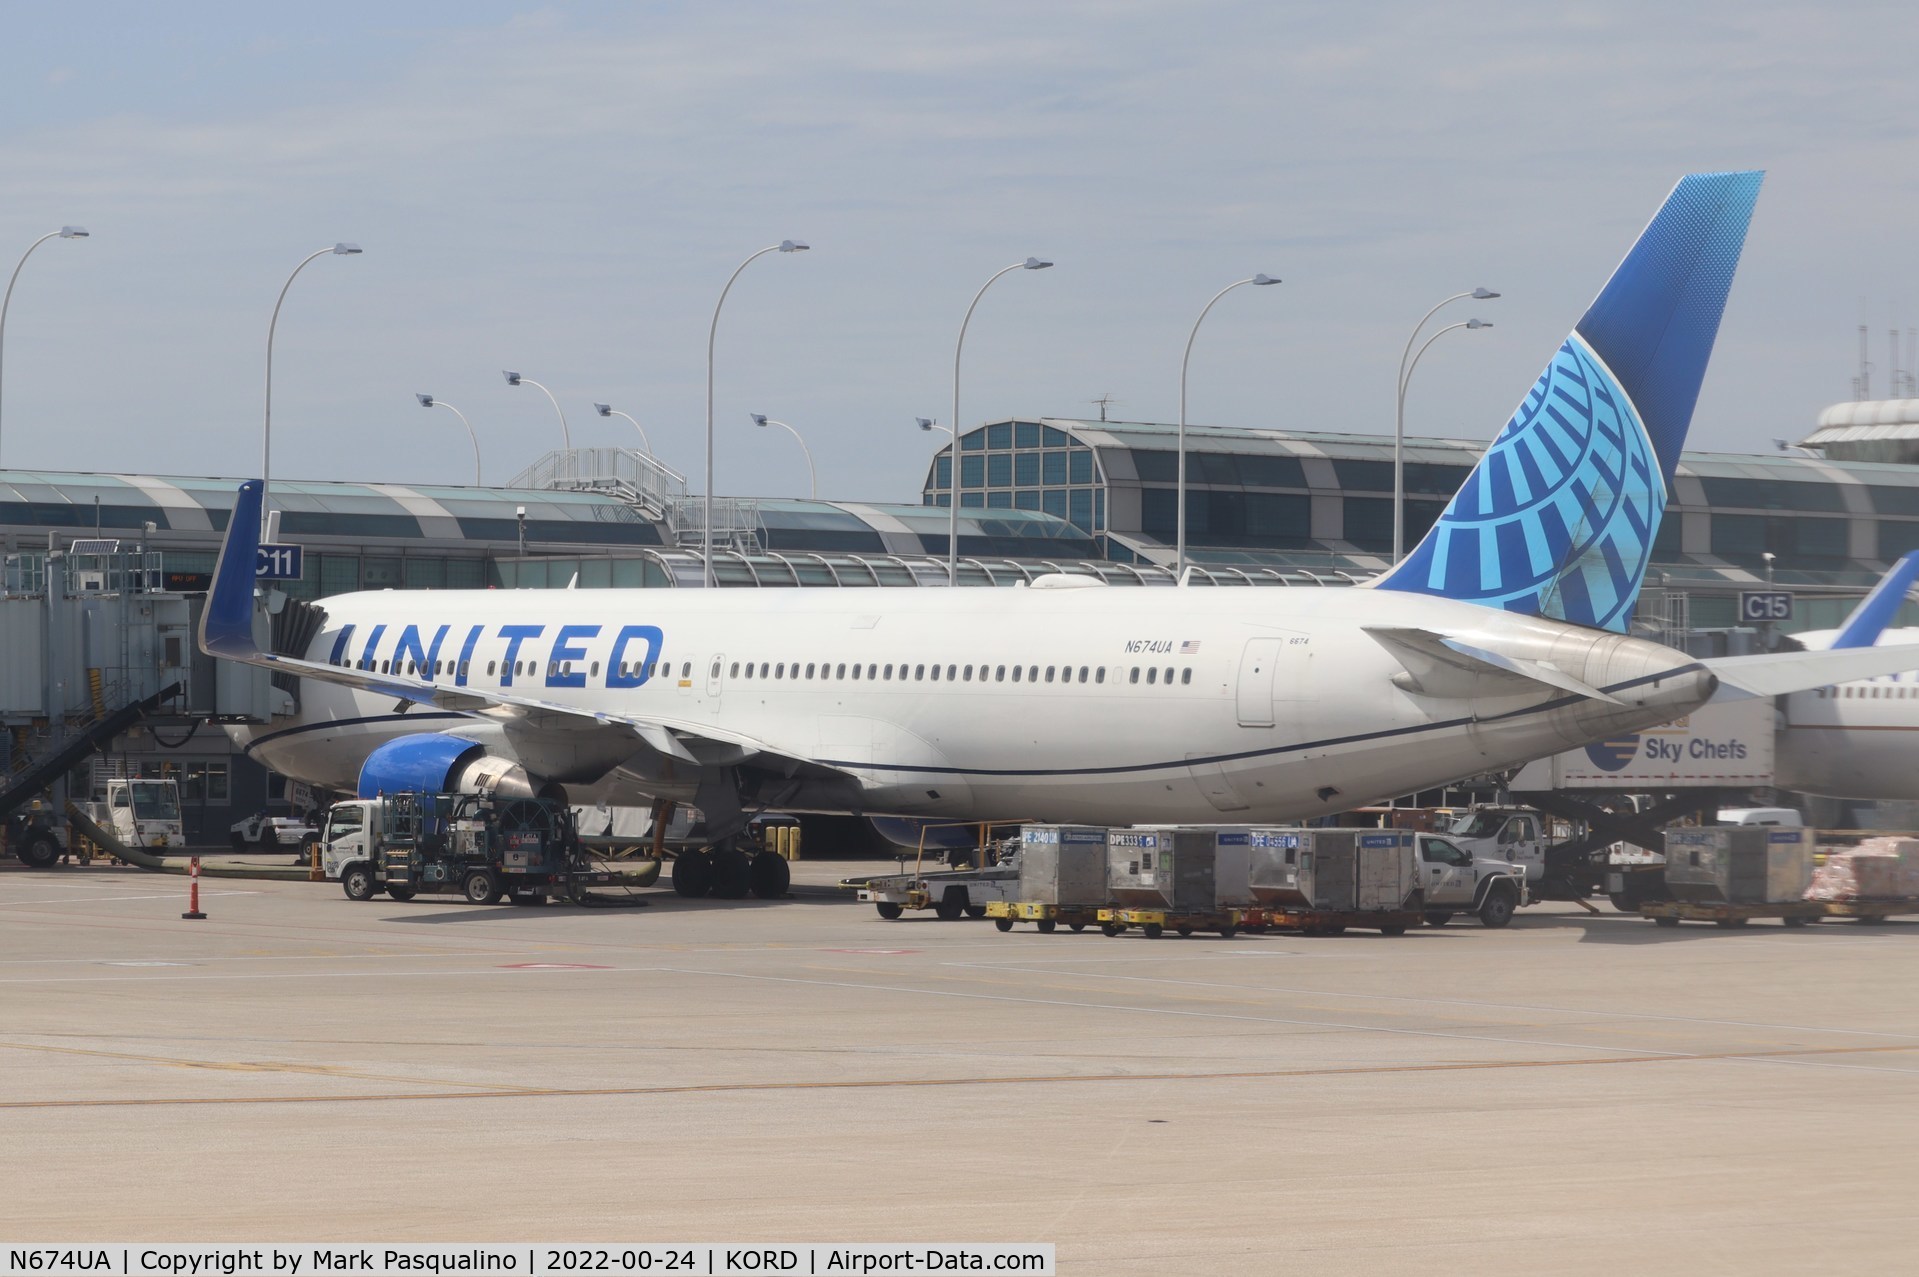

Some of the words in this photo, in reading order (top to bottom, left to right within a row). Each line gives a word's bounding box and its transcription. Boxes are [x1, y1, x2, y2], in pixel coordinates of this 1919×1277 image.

[256, 549, 292, 575] C11
[1746, 596, 1788, 618] C15
[1124, 640, 1173, 654] N674UA
[1289, 637, 1310, 645] 6674
[329, 624, 664, 688] UNITED
[1646, 738, 1683, 763] Sky
[1689, 738, 1747, 759] Chefs
[1287, 836, 1298, 848] UA
